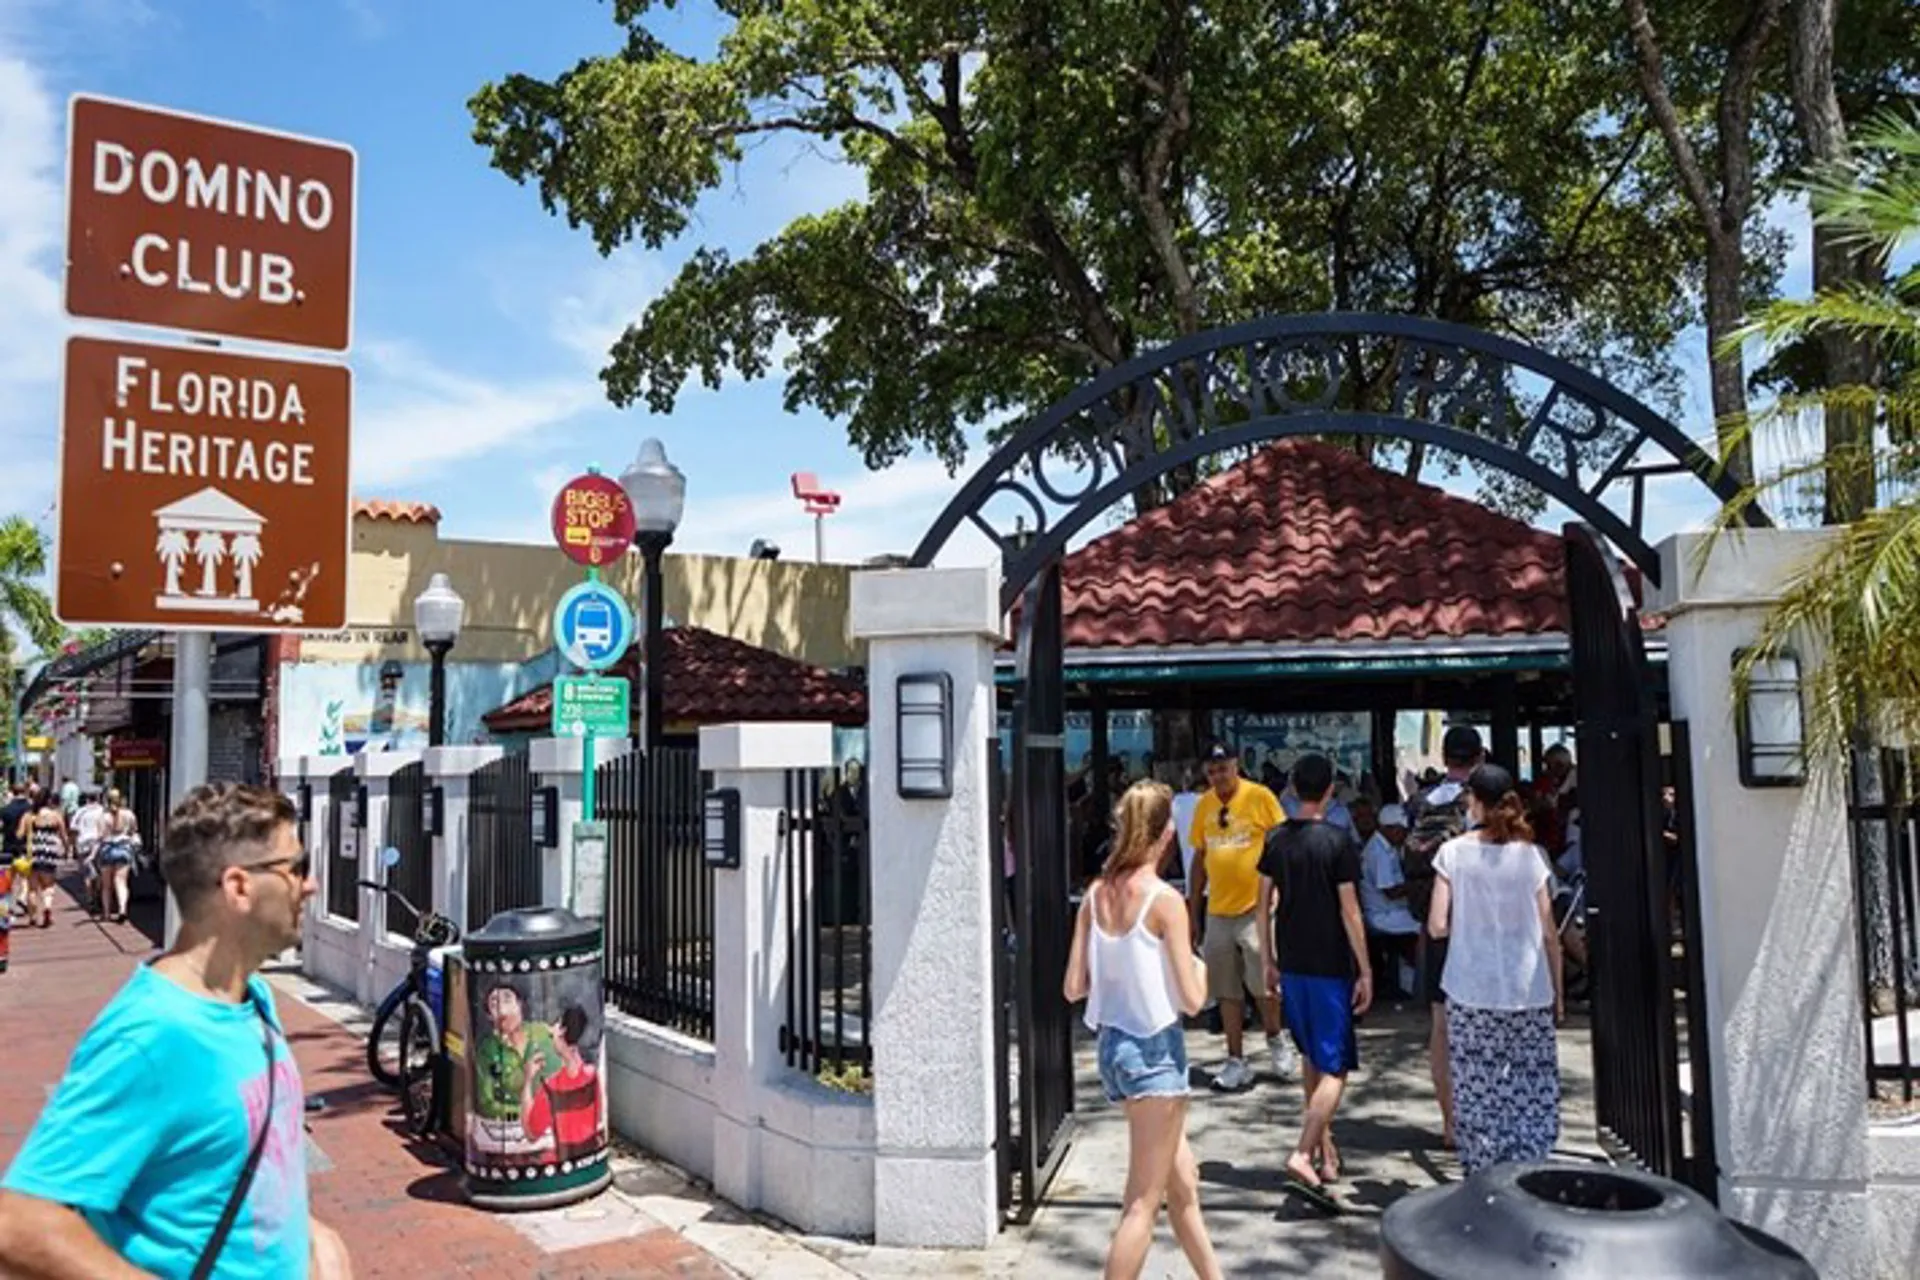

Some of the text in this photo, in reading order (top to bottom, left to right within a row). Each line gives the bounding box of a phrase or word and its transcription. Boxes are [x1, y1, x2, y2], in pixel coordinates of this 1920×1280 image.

[94, 140, 333, 230] DOMINO
[132, 233, 294, 304] CLUB
[116, 355, 305, 425] FLORIDA
[102, 417, 314, 485] HERITAGE
[968, 338, 1695, 545] DOMINO PARK
[566, 507, 614, 528] STOP
[355, 631, 369, 643] IN
